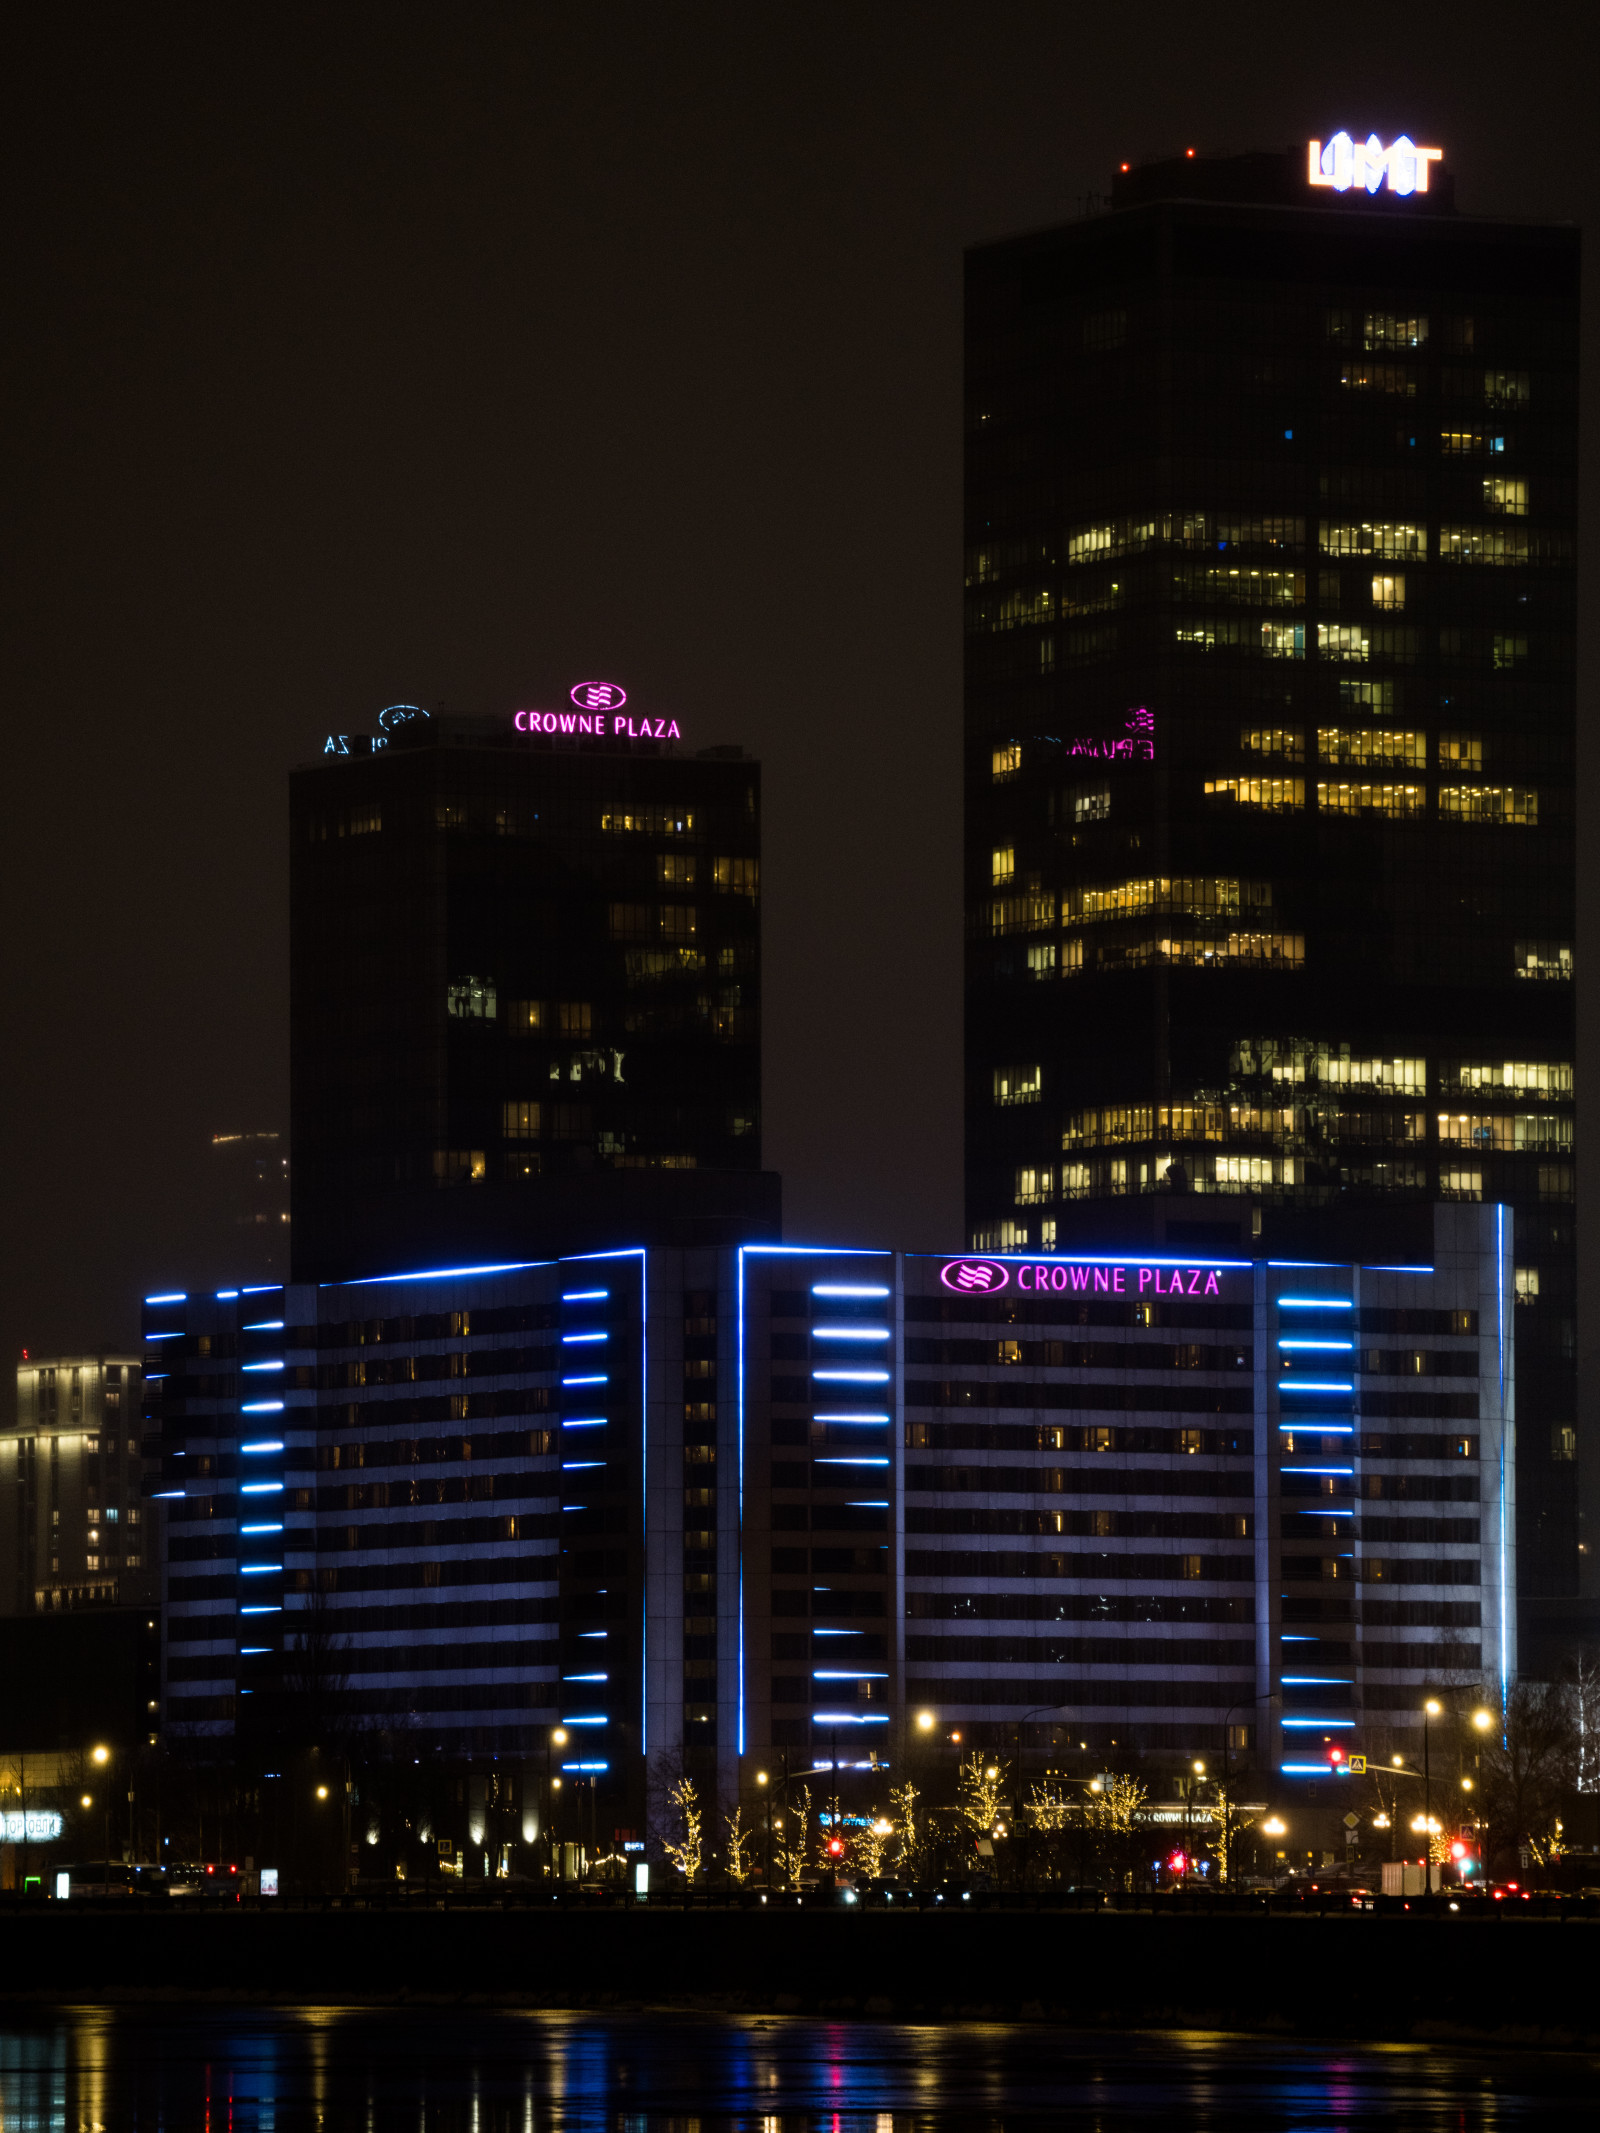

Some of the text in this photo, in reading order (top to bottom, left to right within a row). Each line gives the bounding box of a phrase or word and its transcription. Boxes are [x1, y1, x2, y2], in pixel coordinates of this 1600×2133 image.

[514, 711, 681, 740] CROWNE PLAZA
[1017, 1265, 1220, 1295] CROWNE PLAZA
